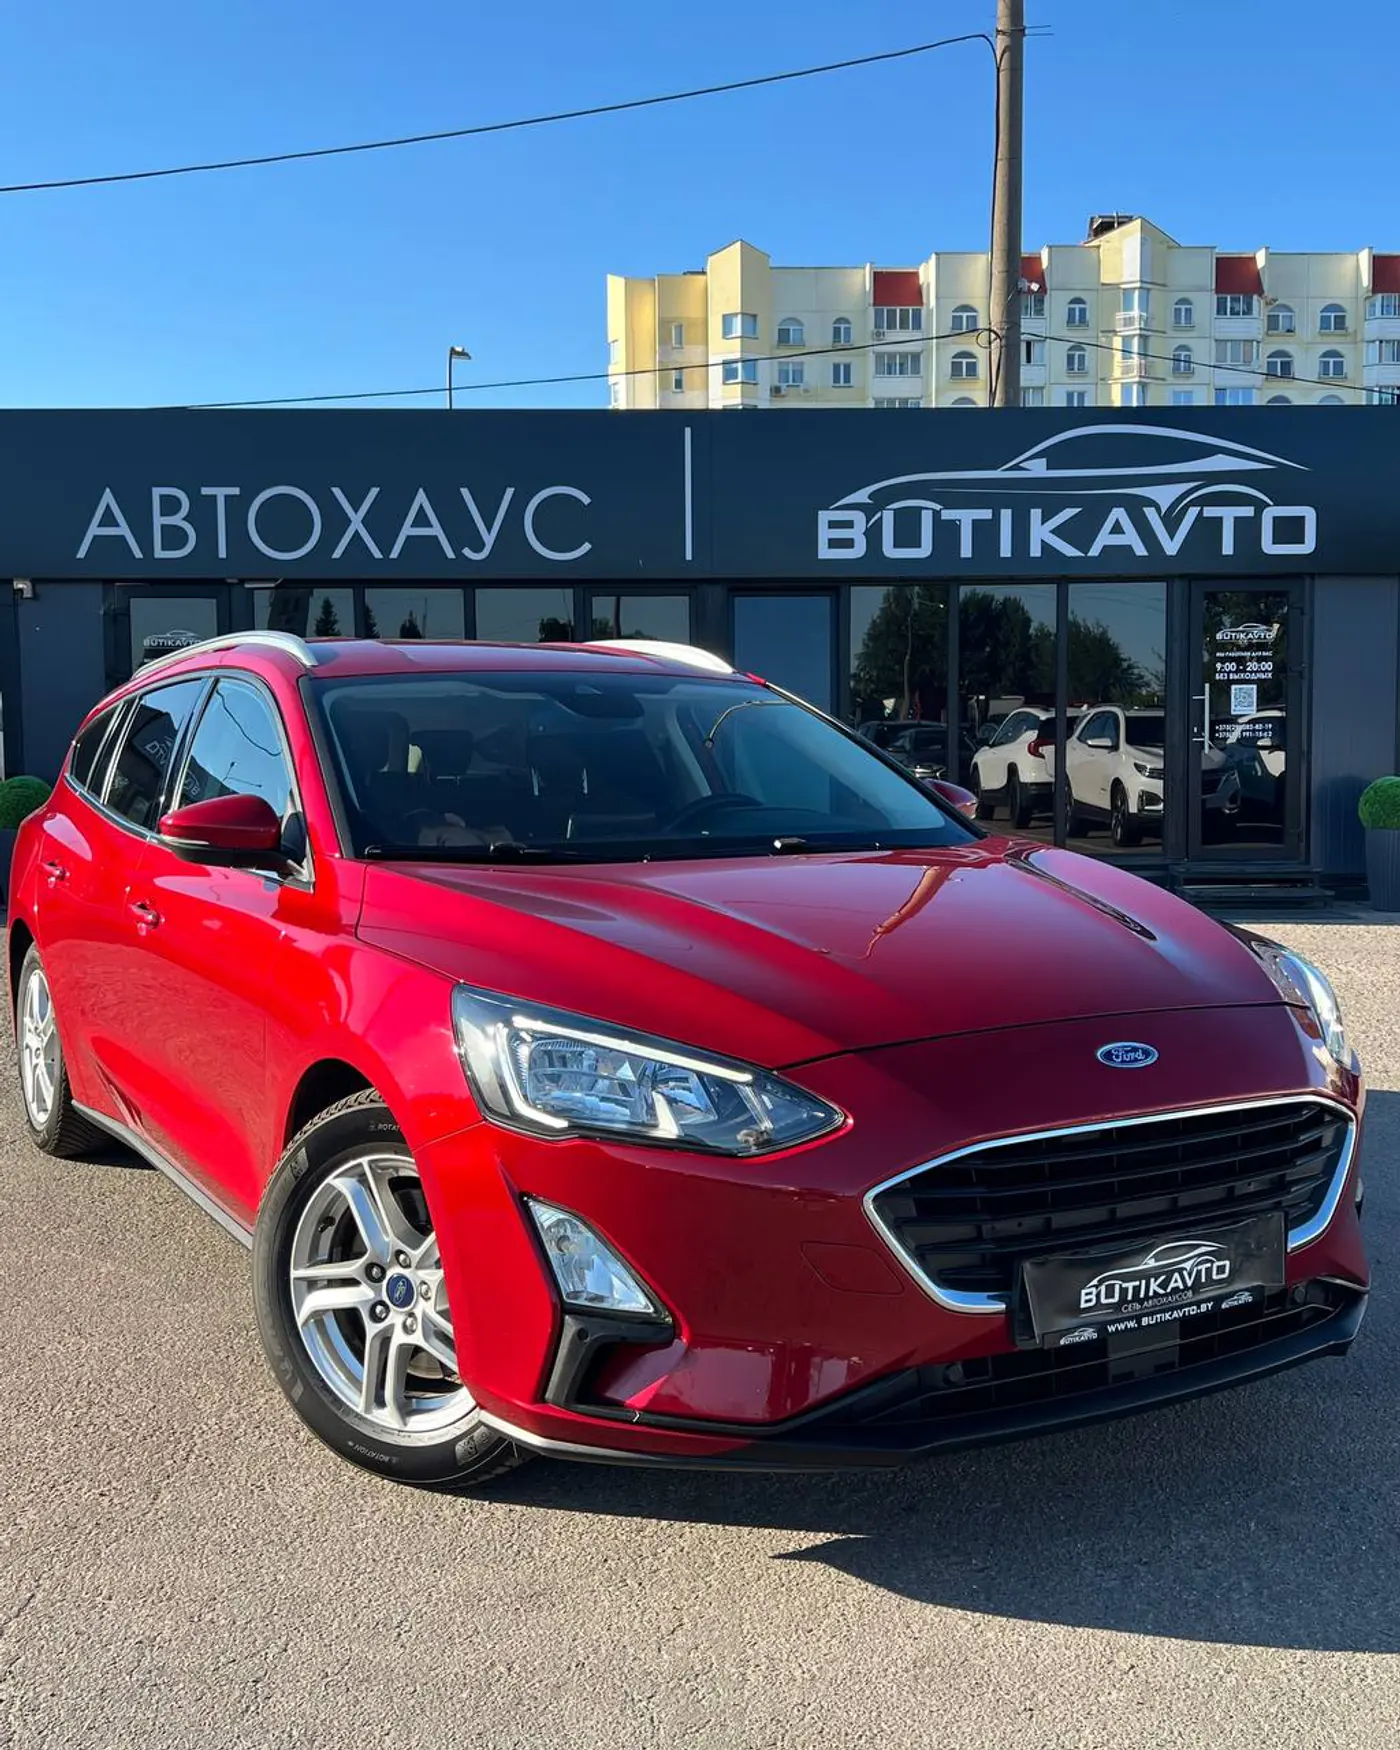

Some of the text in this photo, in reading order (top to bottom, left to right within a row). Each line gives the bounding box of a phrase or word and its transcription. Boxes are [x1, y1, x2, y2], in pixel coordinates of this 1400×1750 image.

[76, 485, 593, 562] АВТОХАУС
[817, 506, 1318, 559] BUTIKAVTO
[1215, 631, 1273, 640] BUTIKAVTO
[1215, 662, 1237, 672] 9:00
[1246, 662, 1273, 671] 20:00
[1229, 672, 1273, 680] ВЫХОДНЫХ
[1111, 1047, 1146, 1062] Ford
[1079, 1260, 1230, 1309] BUTIKAVTO
[1121, 1290, 1193, 1313] СЕТЬ АВТОХАУСОВ
[1107, 1301, 1214, 1333] WWW. BUTIKAVTO.BY
